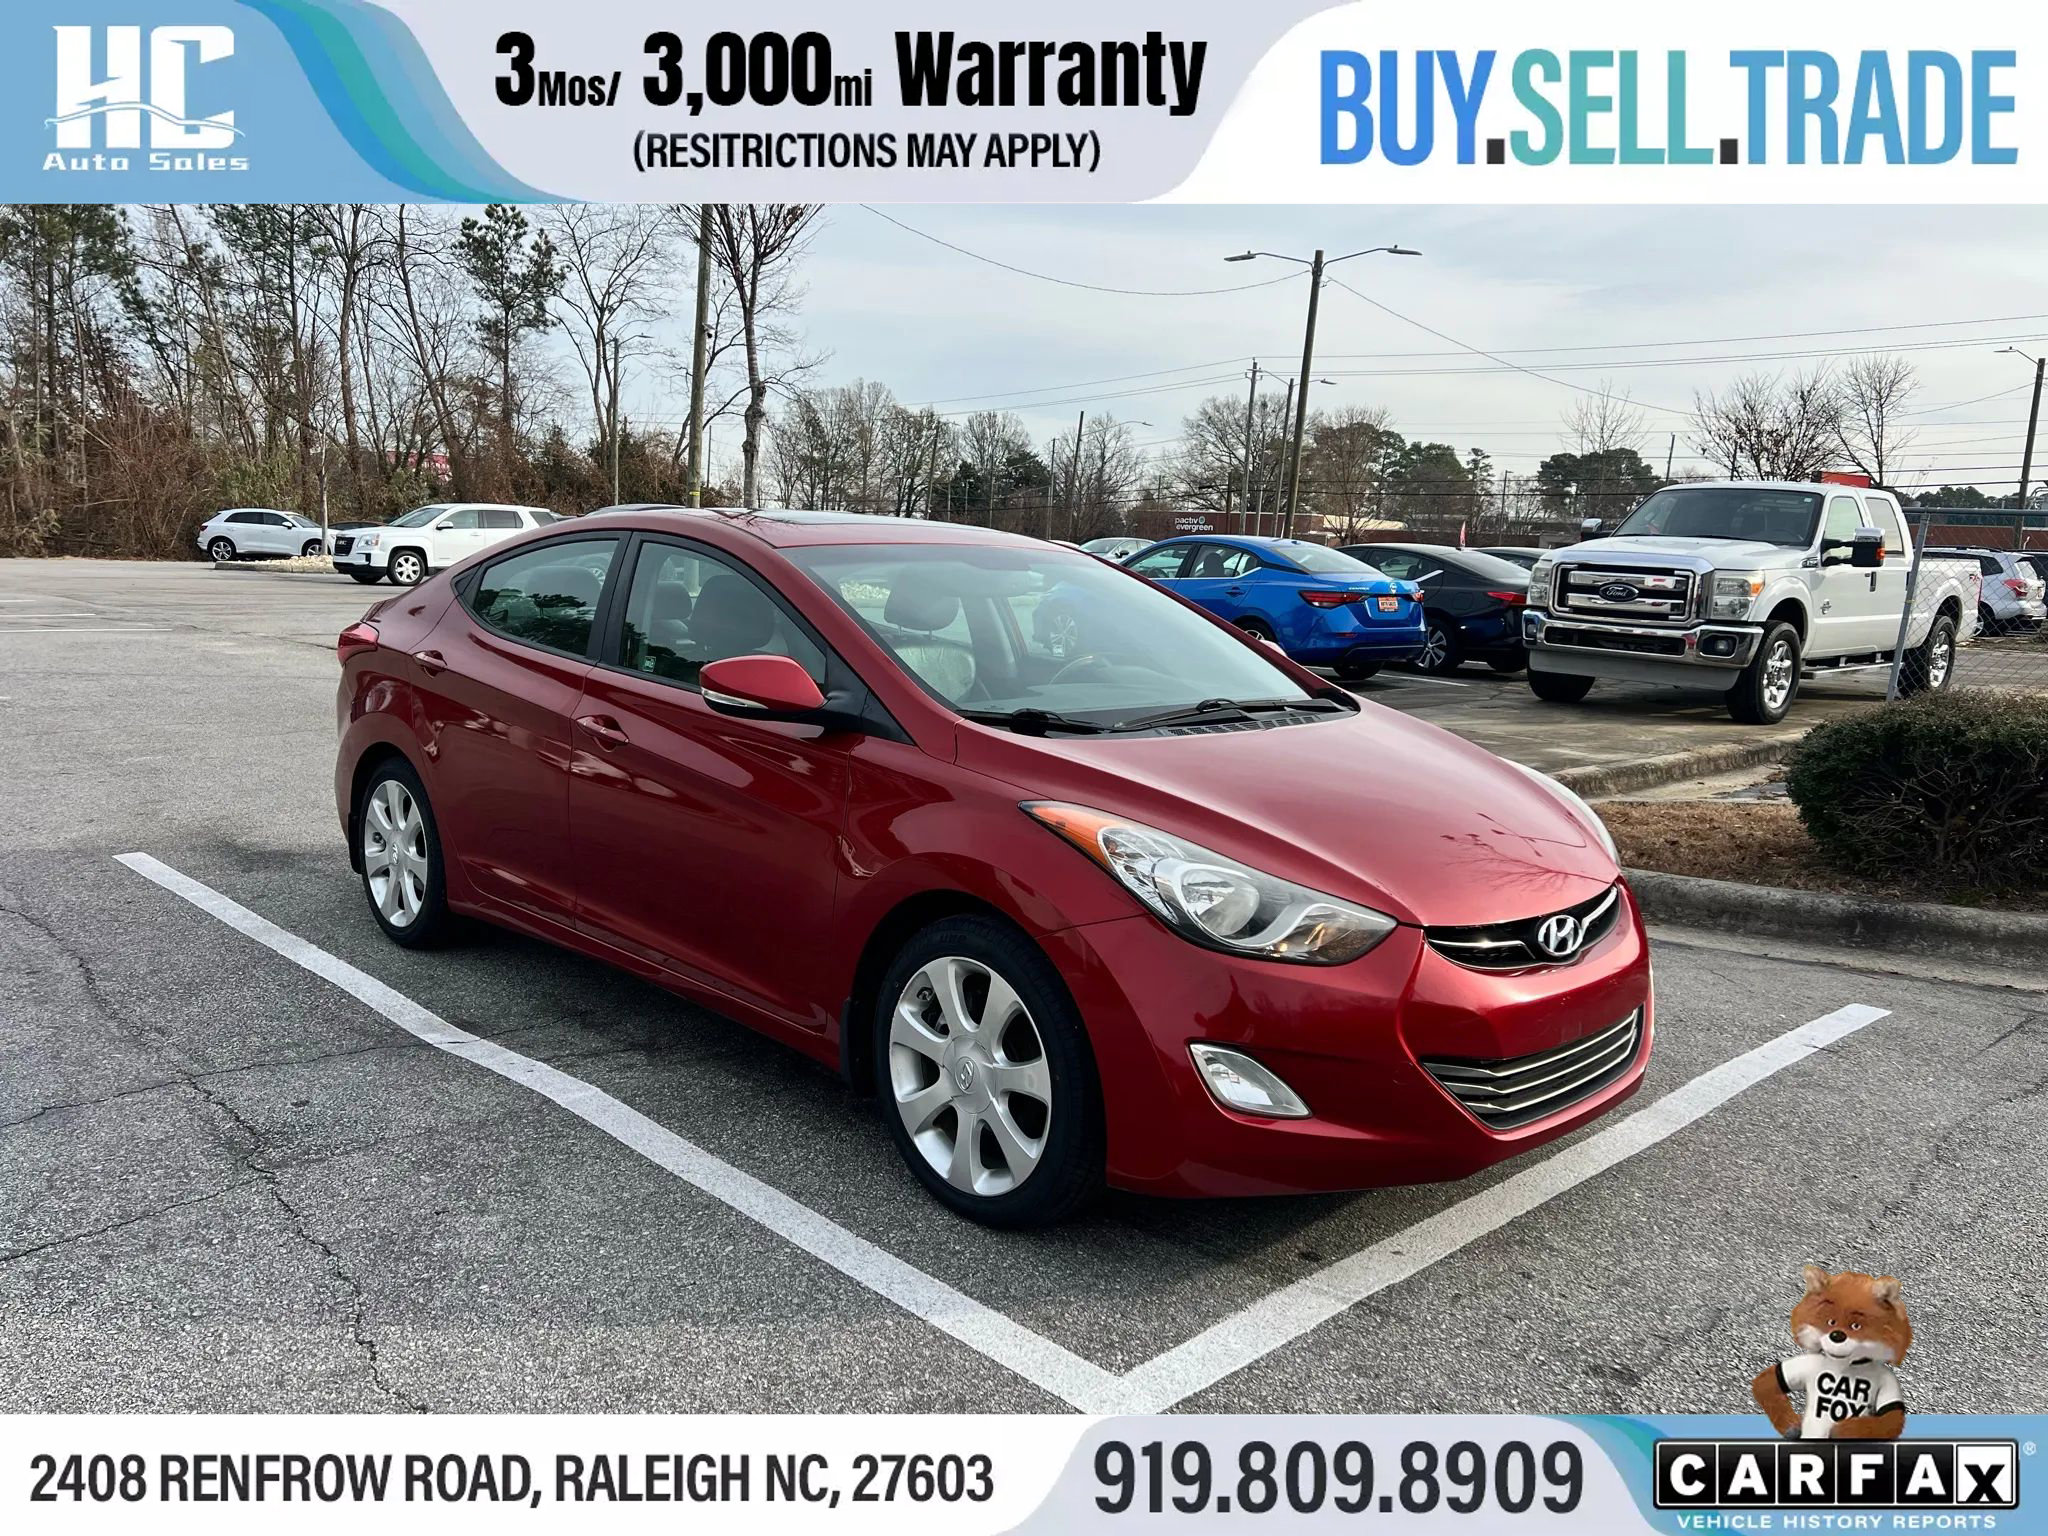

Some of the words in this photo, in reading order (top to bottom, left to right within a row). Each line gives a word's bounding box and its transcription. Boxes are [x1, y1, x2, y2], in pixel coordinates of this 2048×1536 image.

[1175, 516, 1199, 525] pactiv
[1176, 523, 1213, 532] evergreen
[1606, 586, 1629, 597] Ford
